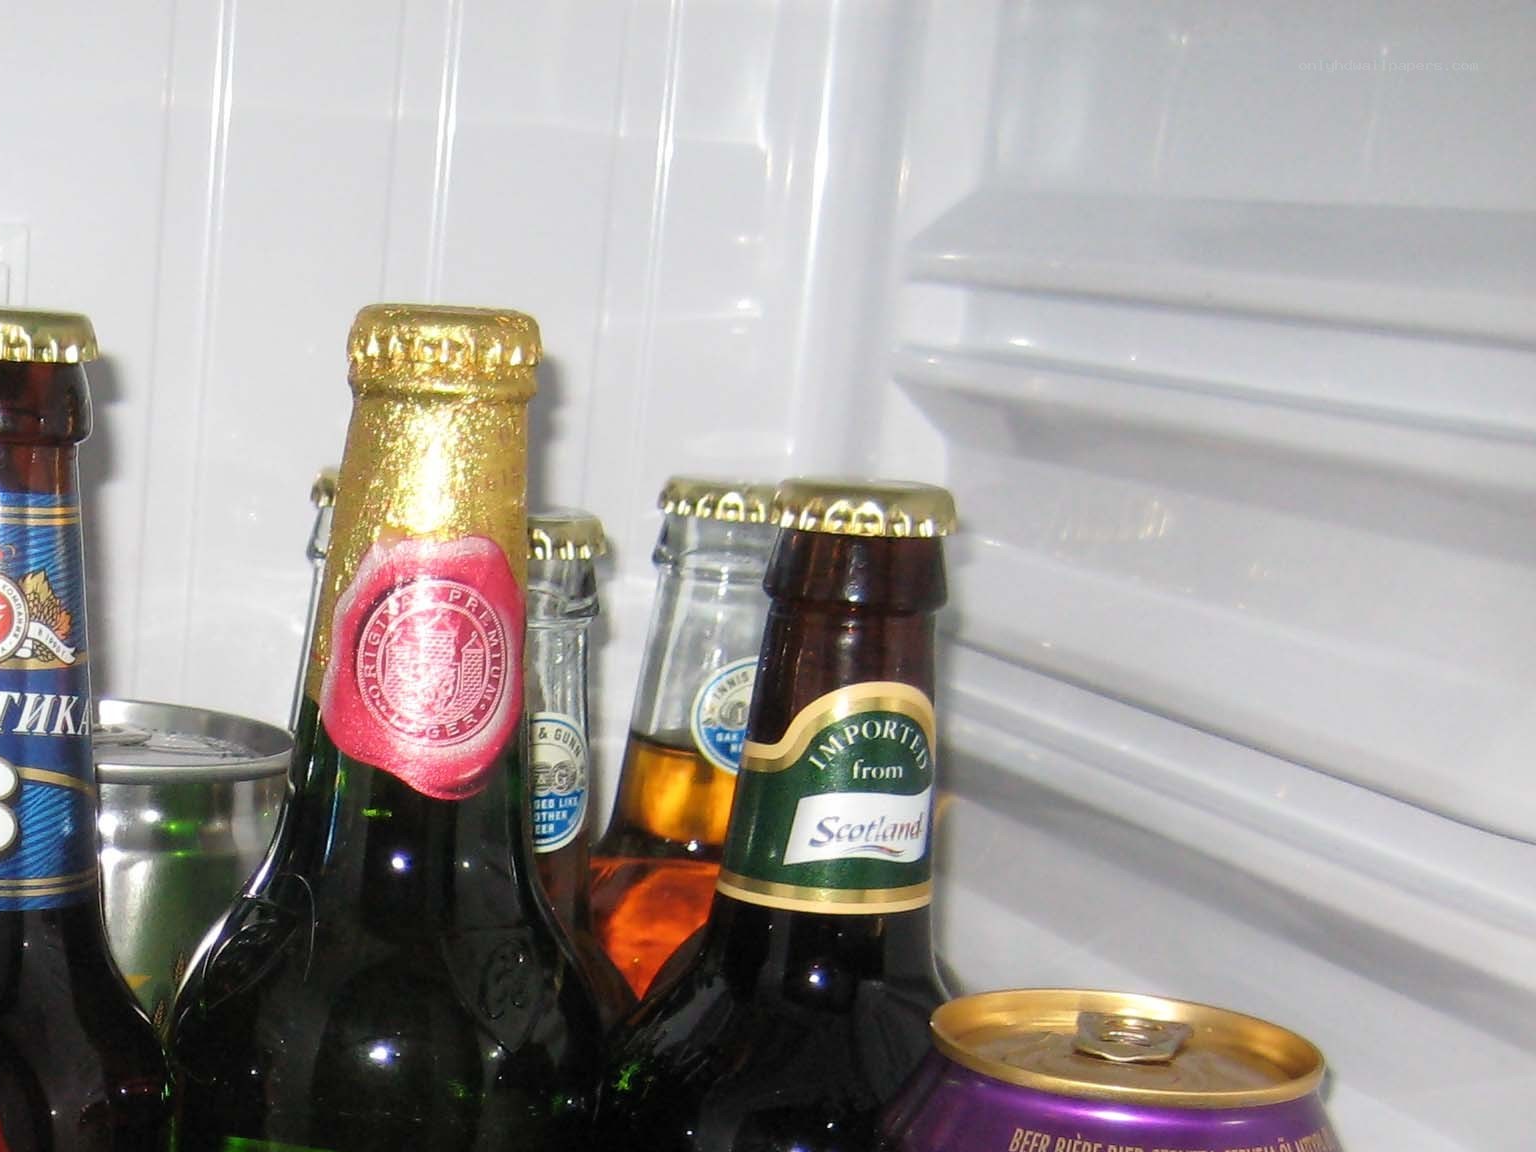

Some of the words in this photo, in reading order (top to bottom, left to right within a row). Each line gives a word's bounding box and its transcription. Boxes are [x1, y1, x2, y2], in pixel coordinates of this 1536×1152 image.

[806, 720, 928, 773] IMPORTED
[851, 758, 904, 781] from
[808, 811, 925, 849] Scotland
